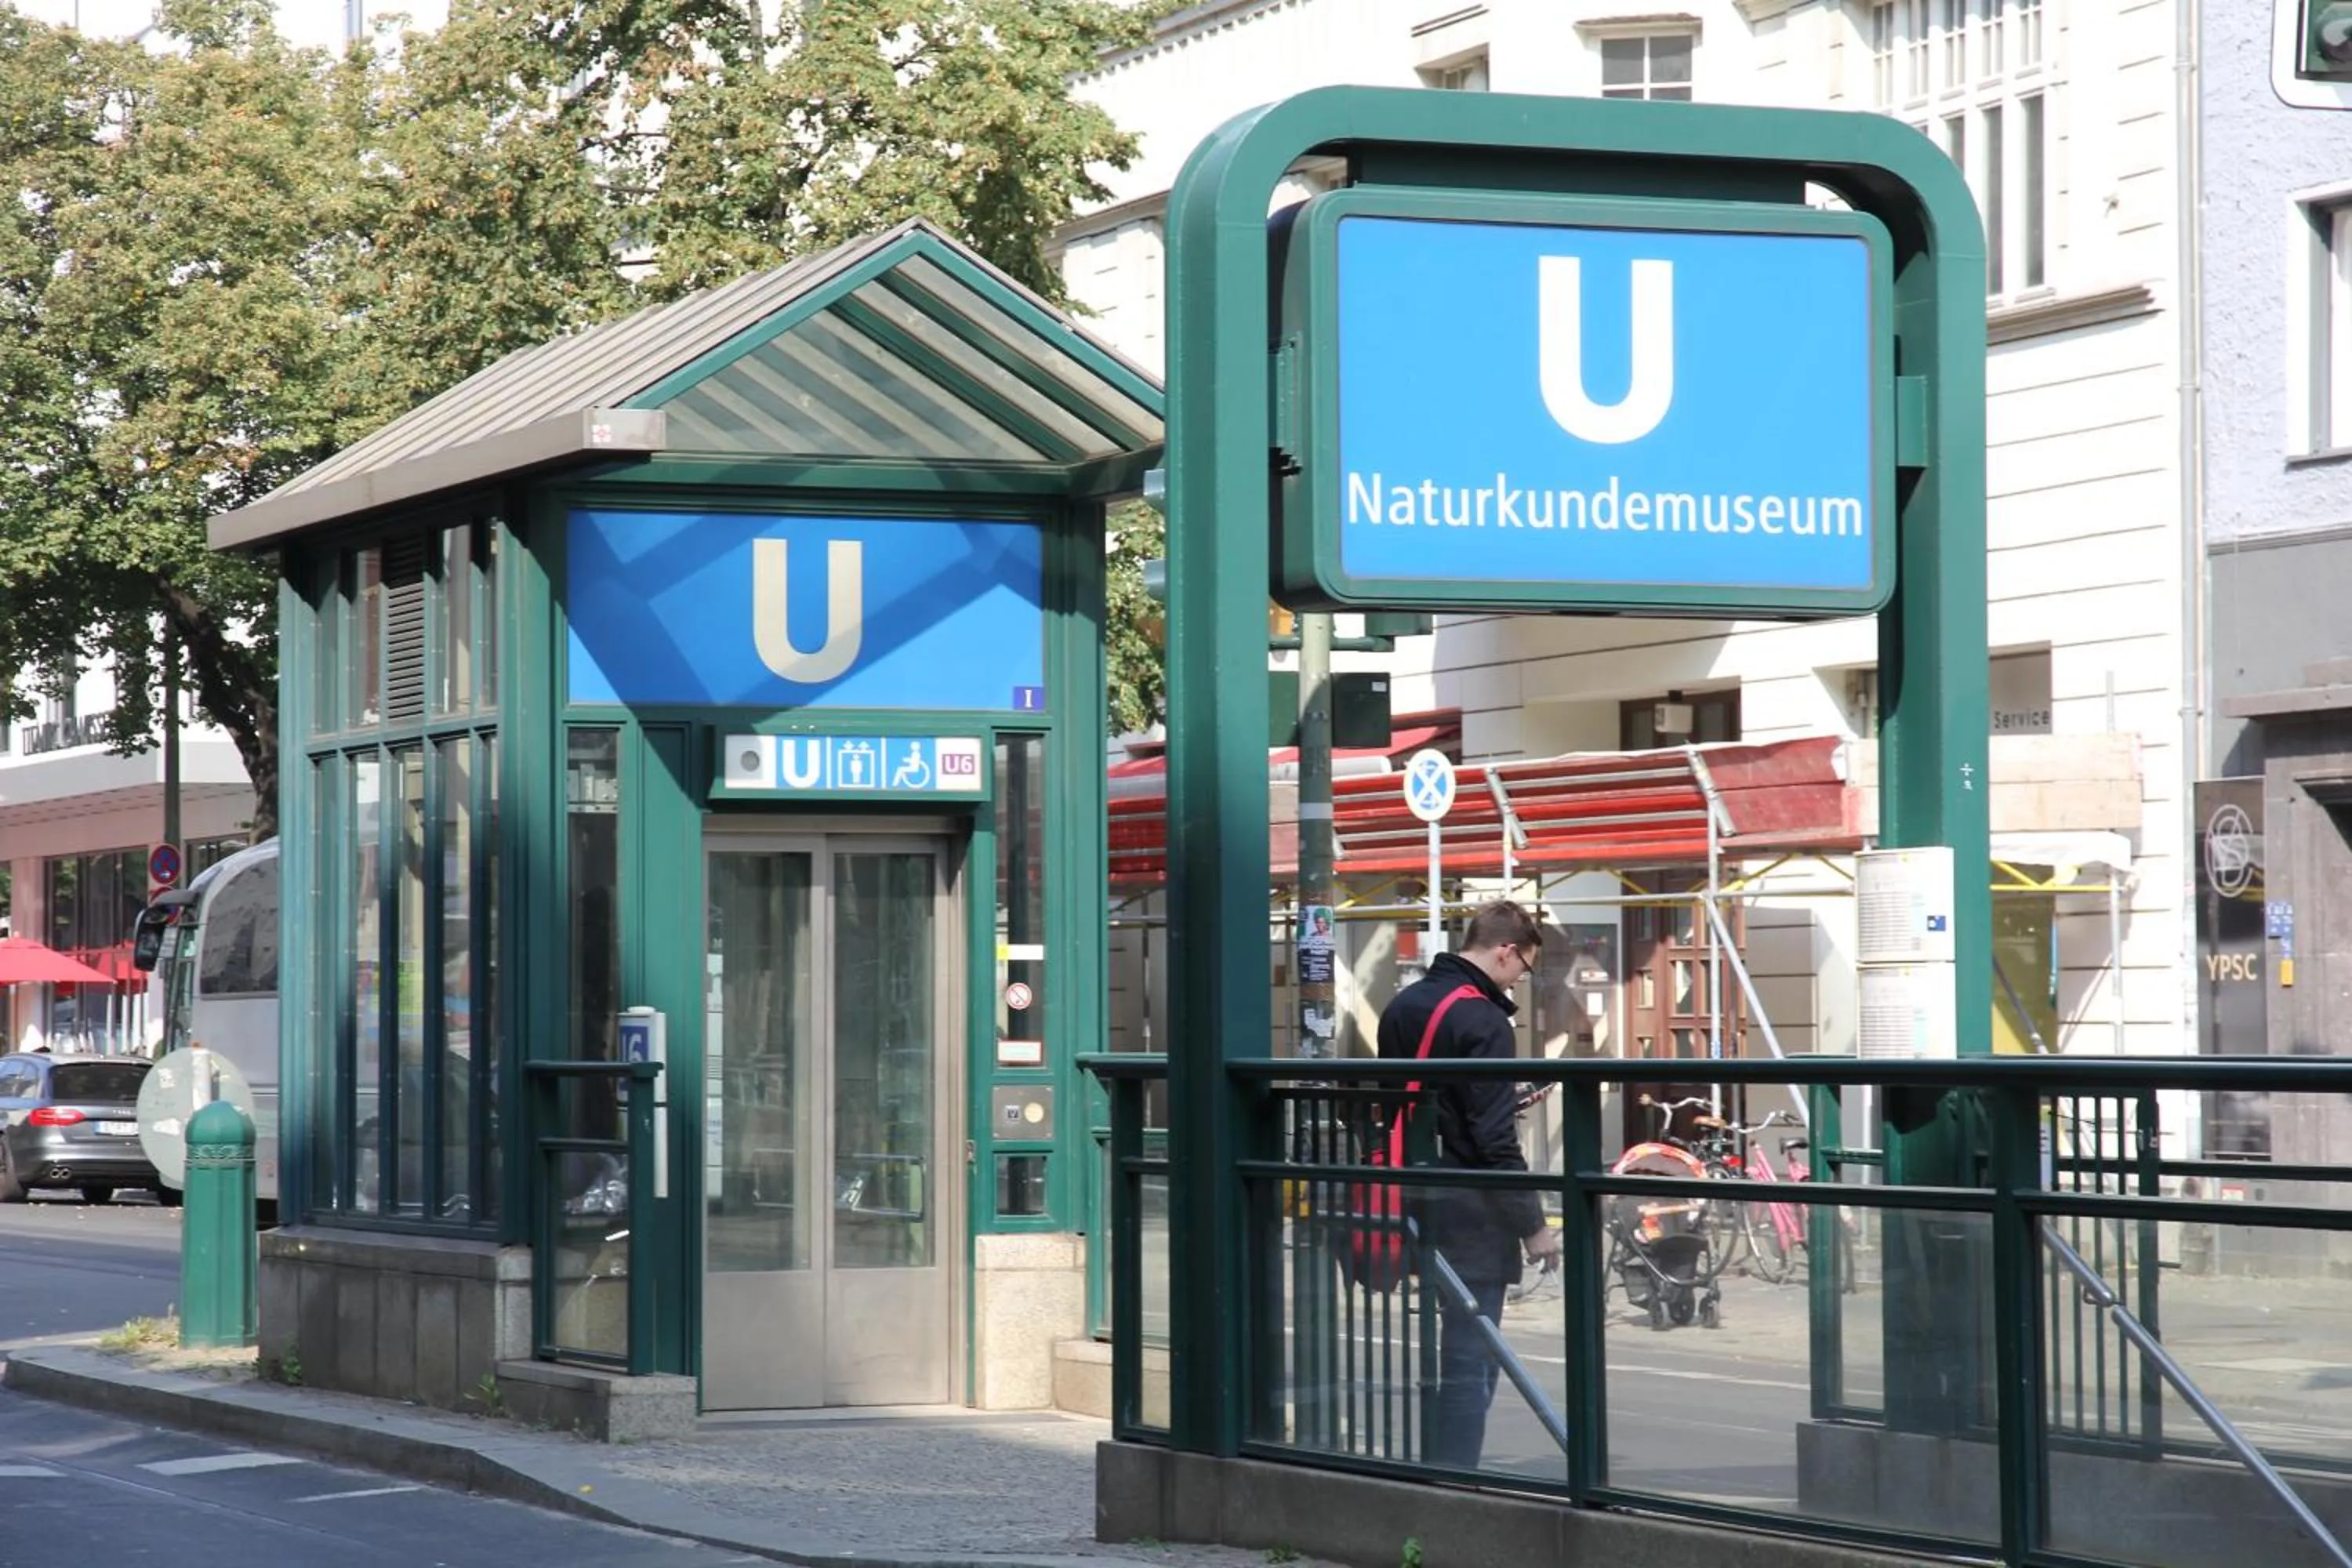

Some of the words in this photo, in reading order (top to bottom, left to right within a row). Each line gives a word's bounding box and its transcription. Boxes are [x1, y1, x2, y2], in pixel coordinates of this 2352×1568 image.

[1537, 255, 1674, 445] U
[1348, 472, 1864, 536] Naturkundemuseum
[751, 537, 864, 684] U
[1994, 709, 2050, 728] Service
[782, 739, 822, 788] U
[945, 756, 973, 772] U6
[2205, 953, 2258, 981] YPSC
